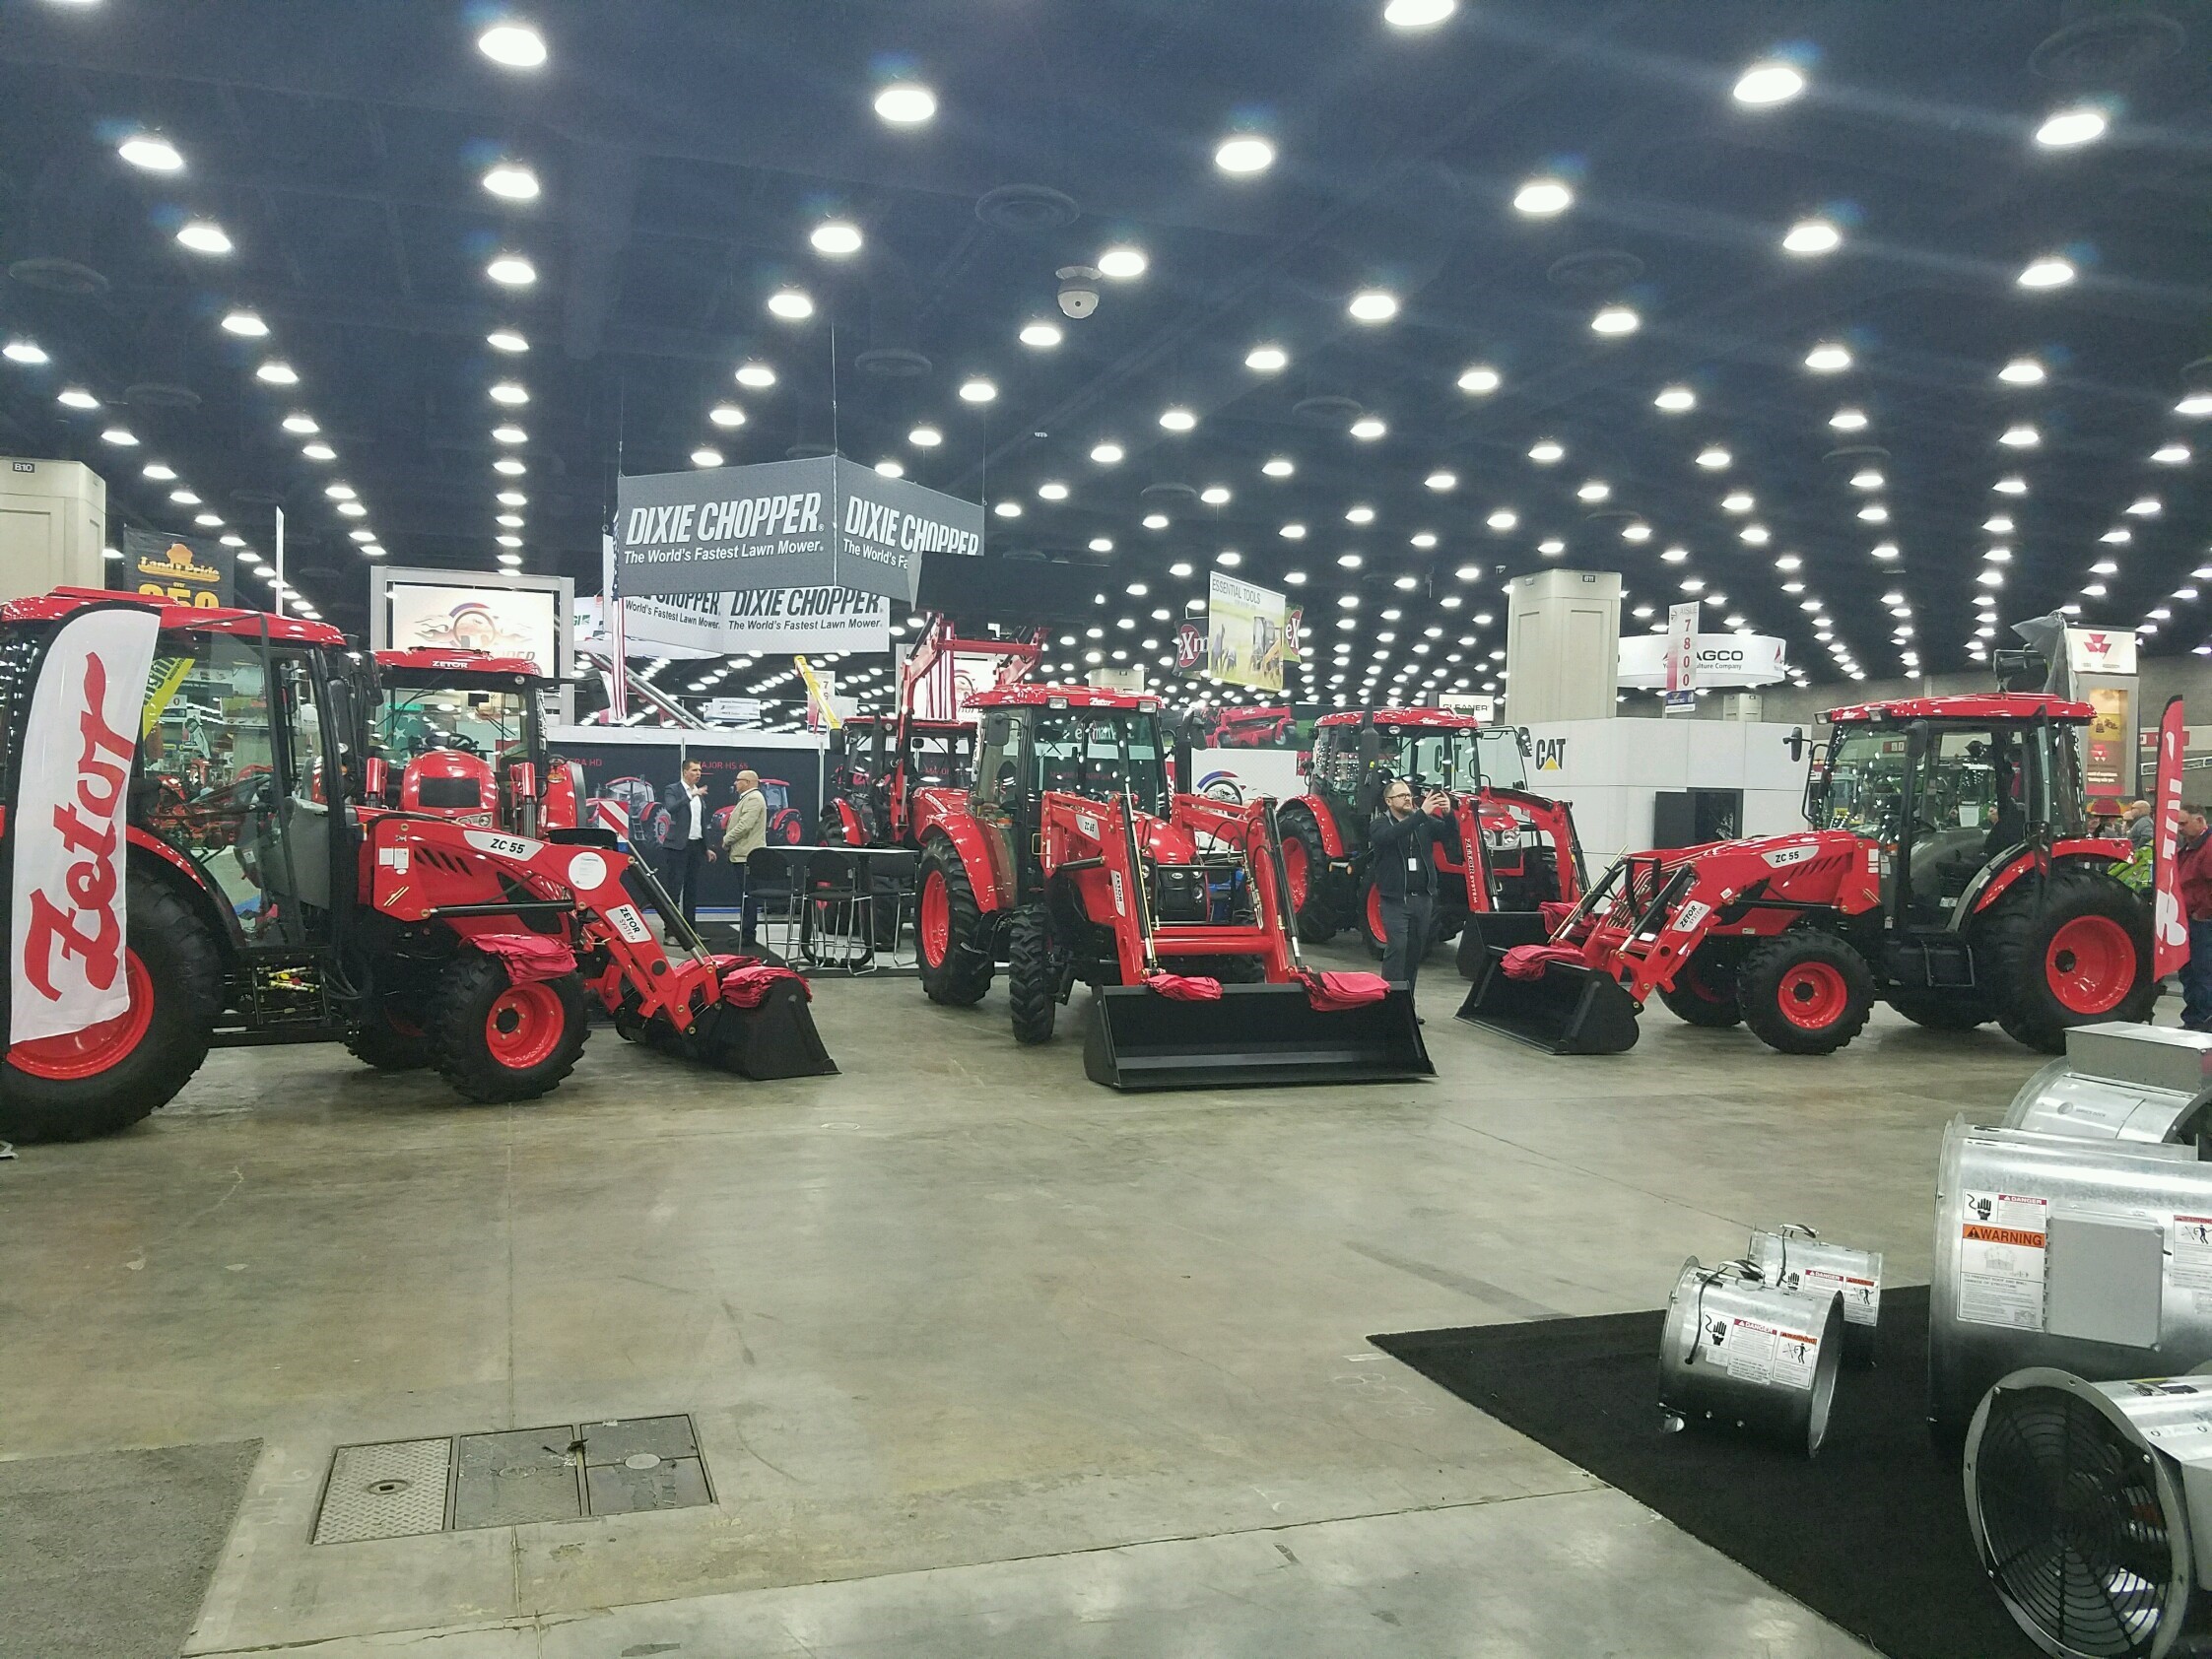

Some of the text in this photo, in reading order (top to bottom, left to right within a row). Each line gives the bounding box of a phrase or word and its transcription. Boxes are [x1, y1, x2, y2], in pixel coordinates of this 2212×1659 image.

[626, 504, 697, 546] DIXIE
[844, 496, 979, 556] DIXIE CHOPPER
[625, 551, 645, 564] The
[647, 548, 692, 564] World's
[694, 546, 739, 562] Fastest
[741, 543, 774, 558] Lawn
[842, 538, 861, 557] The
[862, 544, 897, 567] World's
[1212, 578, 1261, 604] ESSENTIAL TOOLS
[730, 589, 785, 617] DIXIE
[653, 606, 679, 622] Fastest
[680, 614, 698, 626] Lawn
[728, 621, 745, 630] The
[747, 620, 781, 630] World's
[784, 620, 818, 630] Fastest
[820, 620, 845, 630] Lawn
[433, 660, 469, 669] ZETOR
[589, 759, 603, 767] HD
[1434, 744, 1462, 773] CT
[1535, 738, 1567, 770] CAT
[24, 651, 136, 1003] Zetor
[490, 838, 526, 854] ZC 55
[1775, 851, 1800, 863] ZC 55
[1469, 875, 1478, 903] SYSTEM
[619, 907, 640, 933] ZETOR
[1680, 904, 1697, 928] ZETOR
[619, 919, 637, 941] SYSTEM
[2011, 1196, 2043, 1205] DANGER
[1979, 1228, 2043, 1246] WARNING
[1745, 1319, 1774, 1334] DANGER
